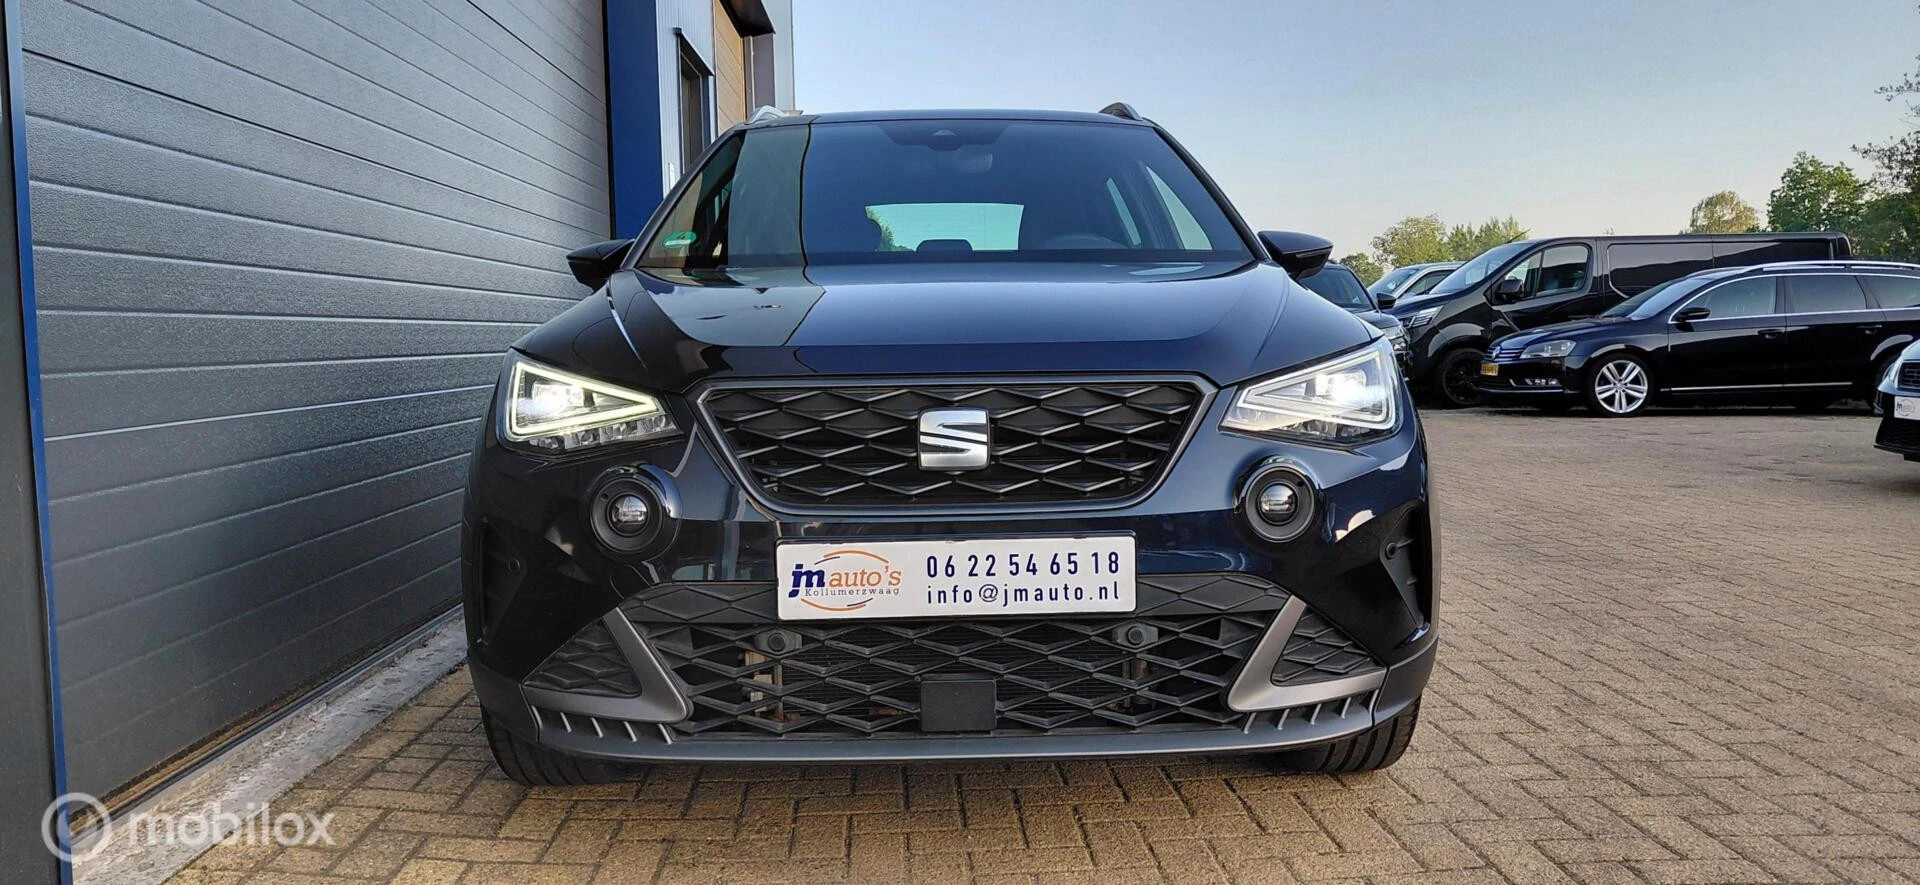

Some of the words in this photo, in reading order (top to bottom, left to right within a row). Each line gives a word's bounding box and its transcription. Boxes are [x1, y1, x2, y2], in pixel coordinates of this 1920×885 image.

[926, 555, 955, 578] 06
[967, 554, 996, 577] 22
[1008, 553, 1038, 576] 54
[1050, 552, 1078, 575] 65
[1091, 551, 1119, 574] 18
[805, 587, 900, 597] Kollumerzwaag
[927, 581, 1119, 607] info@jmauto.nl
